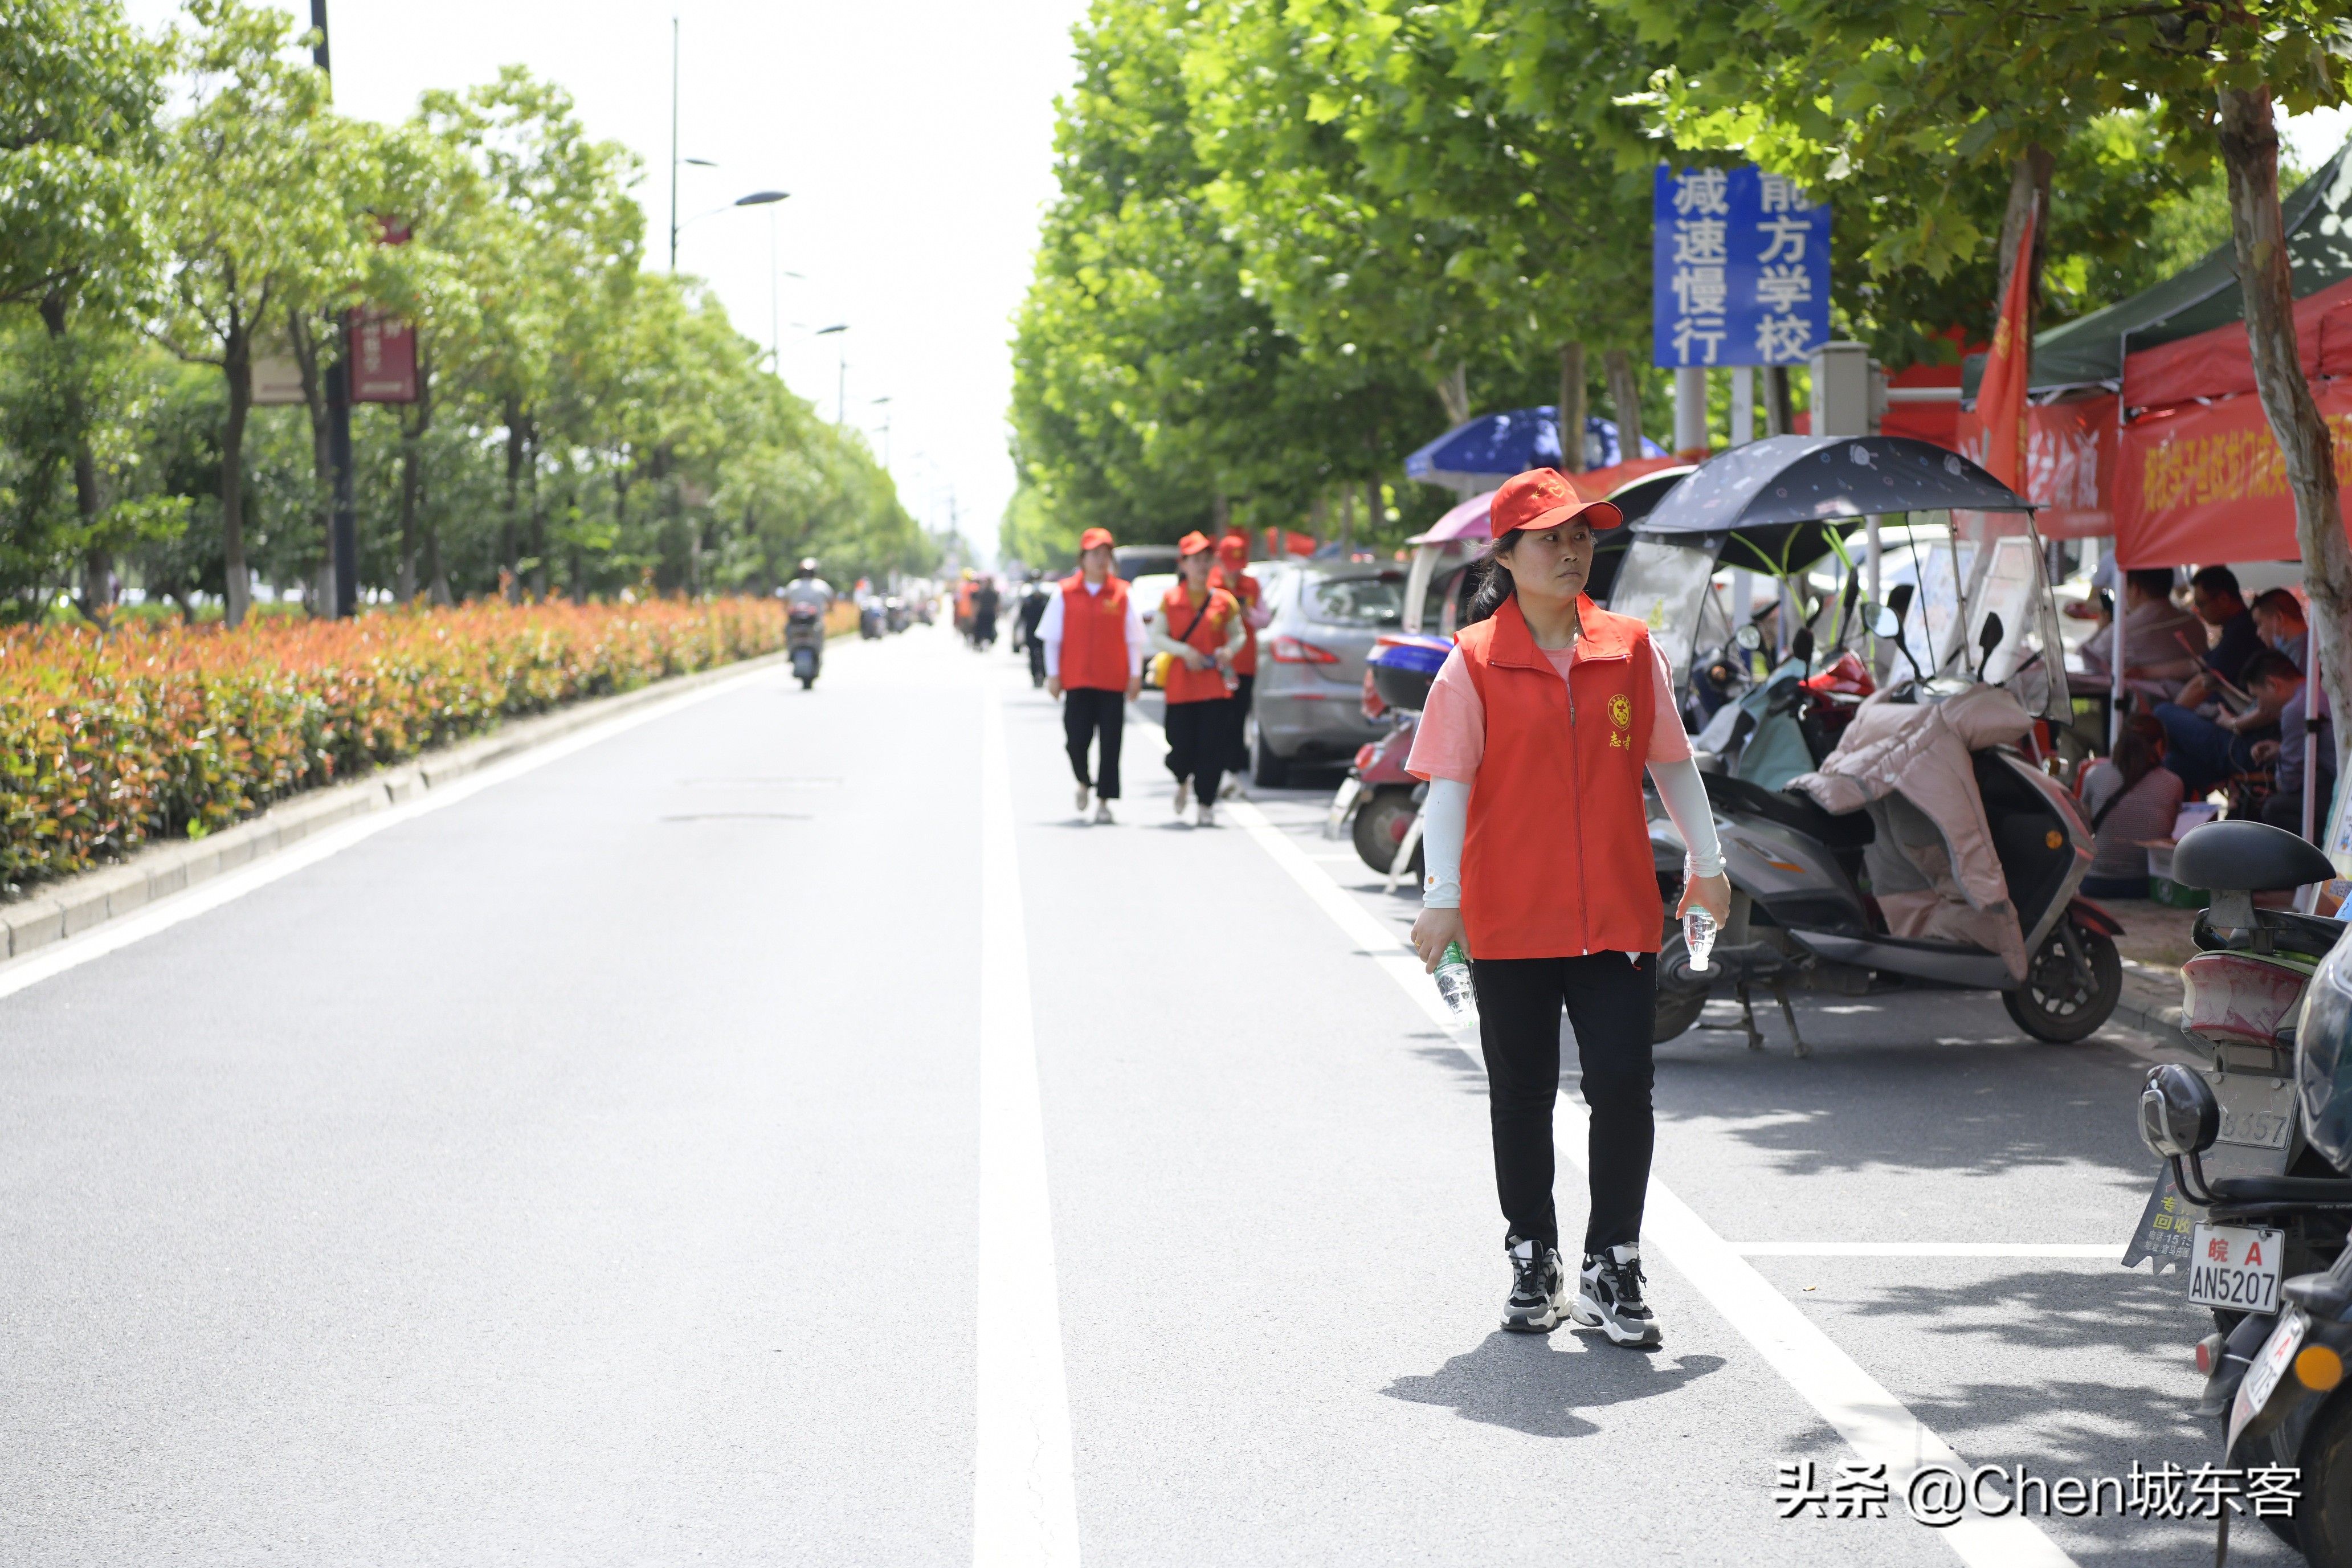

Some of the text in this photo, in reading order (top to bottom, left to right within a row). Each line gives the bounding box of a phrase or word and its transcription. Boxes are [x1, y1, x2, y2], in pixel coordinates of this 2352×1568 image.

[1671, 166, 1729, 365] 减速慢行
[1755, 170, 1812, 364] 前方学校
[1609, 731, 1631, 750] 志者
[2153, 1213, 2191, 1234] 回收
[2208, 1238, 2263, 1266] 皖 A
[2192, 1265, 2275, 1306] AN5207
